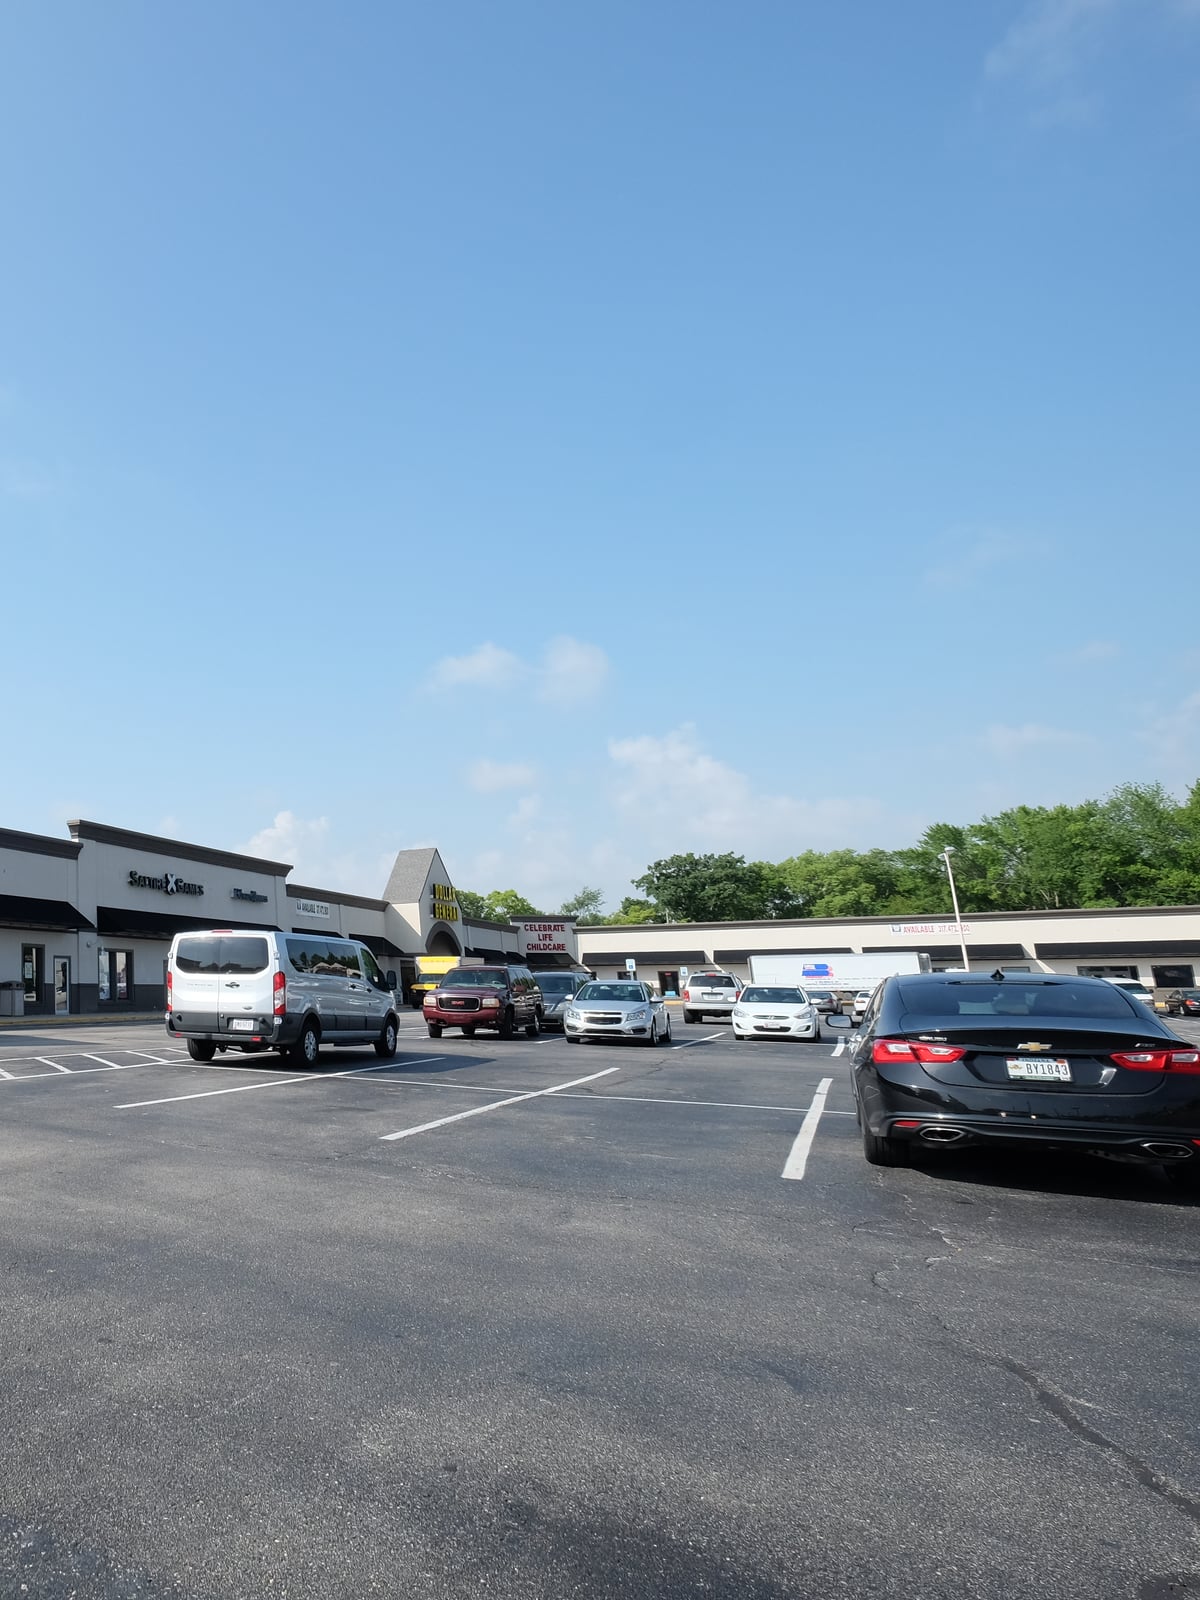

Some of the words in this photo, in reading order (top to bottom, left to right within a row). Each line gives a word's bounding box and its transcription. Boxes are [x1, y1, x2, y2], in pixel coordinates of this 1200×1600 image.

[176, 878, 205, 897] GAMES
[524, 923, 566, 932] CELEBRATE
[903, 925, 935, 933] AVAILABLE
[538, 933, 553, 941] LIFE
[526, 943, 567, 951] CHILDCARE
[1025, 1063, 1069, 1076] BY1843
